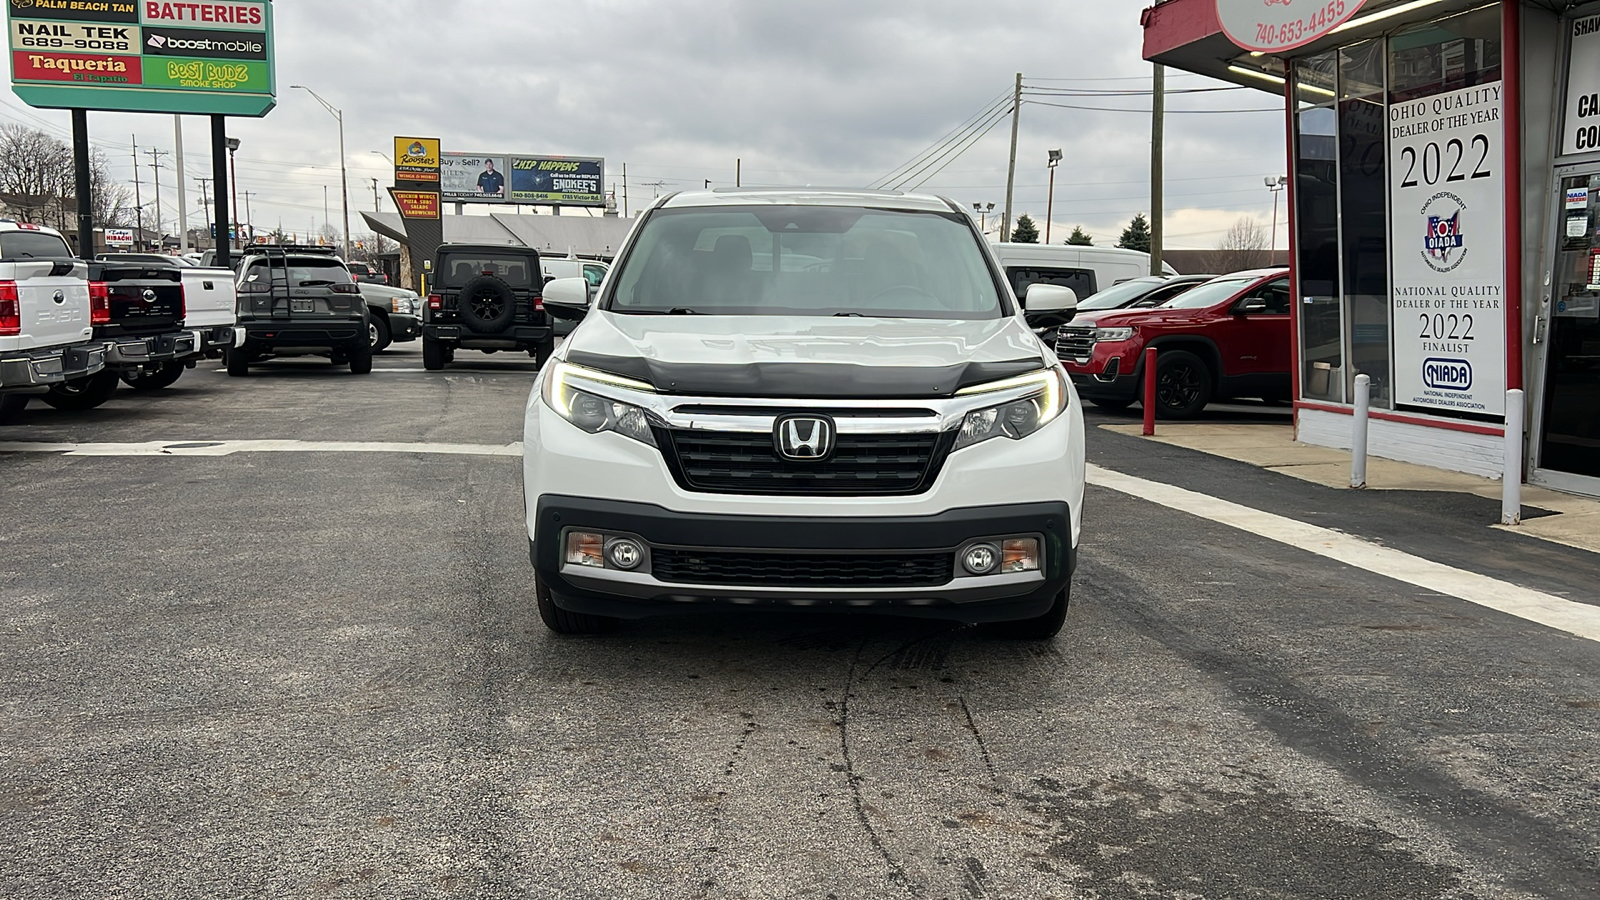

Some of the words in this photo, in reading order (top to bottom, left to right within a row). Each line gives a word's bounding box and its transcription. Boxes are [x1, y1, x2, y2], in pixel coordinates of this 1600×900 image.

[35, 0, 67, 9] PALM
[70, 1, 109, 11] BEACH
[112, 3, 134, 13] TAN
[146, 1, 262, 25] BATTERIES
[1255, 0, 1345, 45] 740-653-4455
[18, 23, 72, 37] NAIL
[81, 26, 130, 40] TEK
[22, 37, 129, 50] 689-9088
[28, 54, 127, 73] Taqueria
[73, 73, 84, 81] El
[180, 79, 211, 88] SMOKE
[212, 80, 237, 89] SHOP
[1390, 102, 1426, 122] OHIO
[1432, 85, 1501, 115] QUALITY
[1577, 93, 1600, 118] CA
[1392, 121, 1430, 139] DEALER
[1431, 117, 1445, 132] OF
[1446, 113, 1468, 129] THE
[1469, 107, 1500, 125] YEAR
[1575, 125, 1600, 150] CO
[400, 154, 435, 165] Roosters
[440, 158, 454, 167] Buy
[461, 158, 480, 167] Sell?
[538, 161, 580, 172] HAPPENS
[1400, 133, 1491, 189] 2022
[1420, 198, 1432, 215] OHIO
[1431, 191, 1468, 211] INDEPENDENT
[1429, 235, 1457, 249] OIADA
[1395, 286, 1447, 296] NATIONAL
[1451, 285, 1501, 297] QUALITY
[1396, 299, 1431, 309] DEALER
[1434, 299, 1446, 309] OF
[1449, 299, 1469, 309] THE
[1472, 299, 1500, 309] YEAR
[1419, 313, 1475, 341] 2022
[1422, 341, 1470, 353] FINALIST
[1426, 364, 1468, 385] NIADA
[1423, 390, 1444, 398] NATIONAL
[1444, 392, 1473, 400] INDEPENDENT
[1456, 401, 1486, 410] ASSOCIATION
